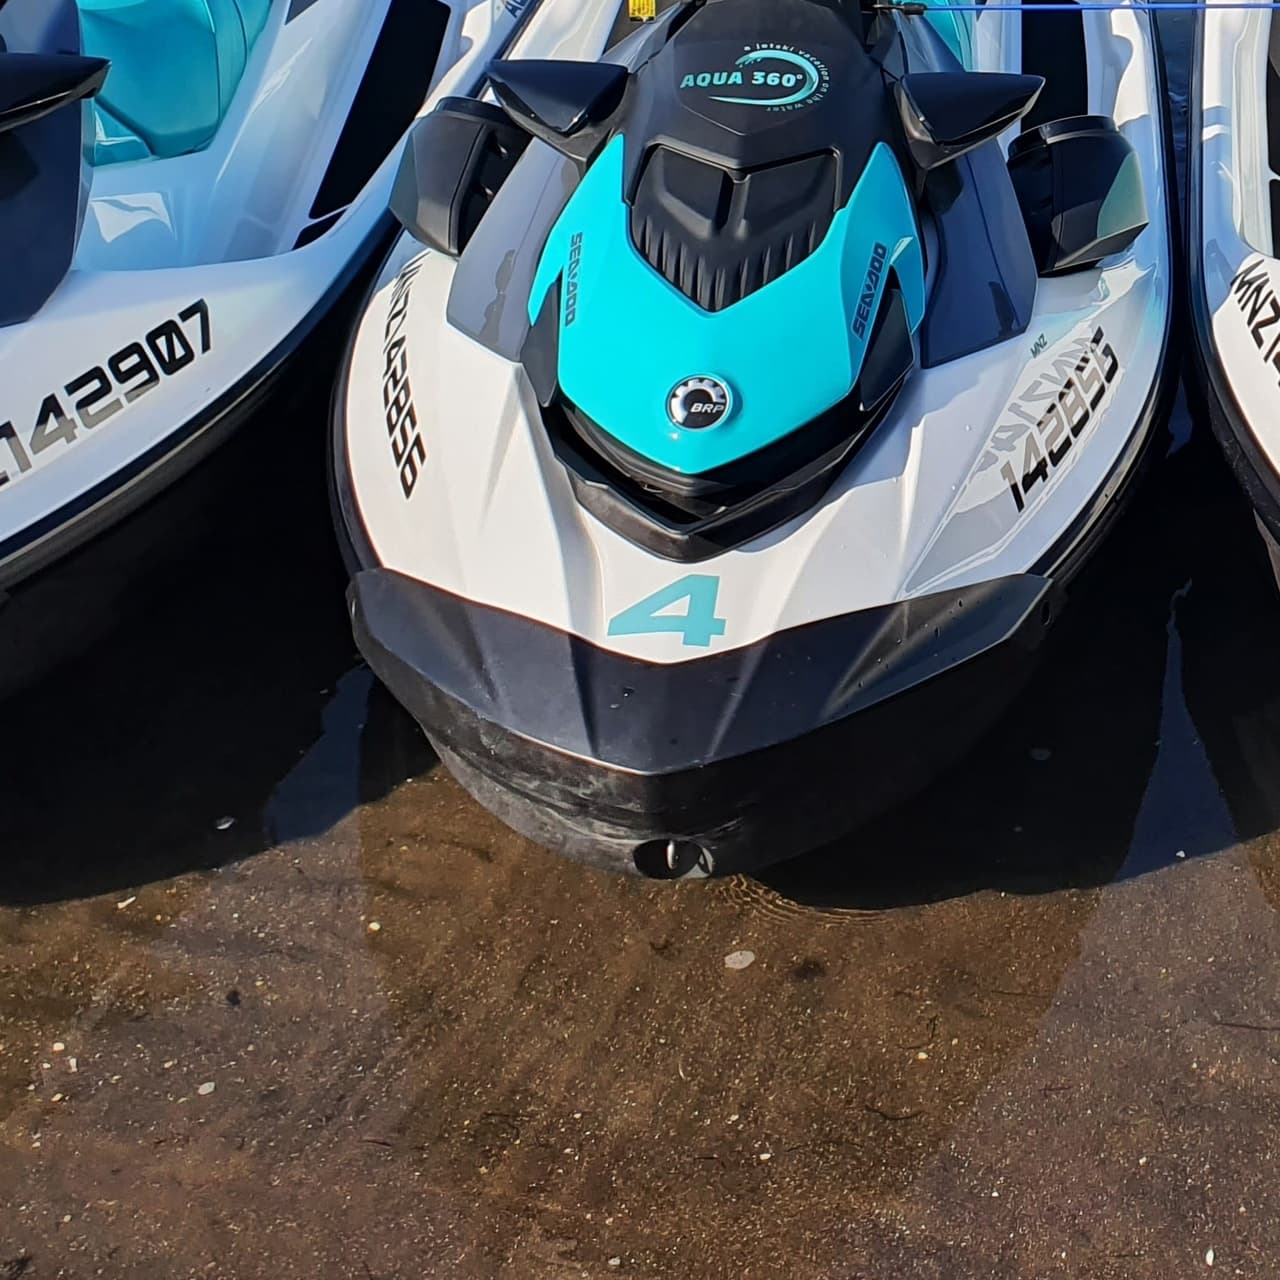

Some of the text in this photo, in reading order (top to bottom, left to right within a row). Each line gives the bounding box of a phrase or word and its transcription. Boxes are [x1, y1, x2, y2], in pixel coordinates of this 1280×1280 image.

[680, 71, 743, 88] AQUA
[690, 403, 724, 413] BRP
[607, 574, 726, 647] 4
